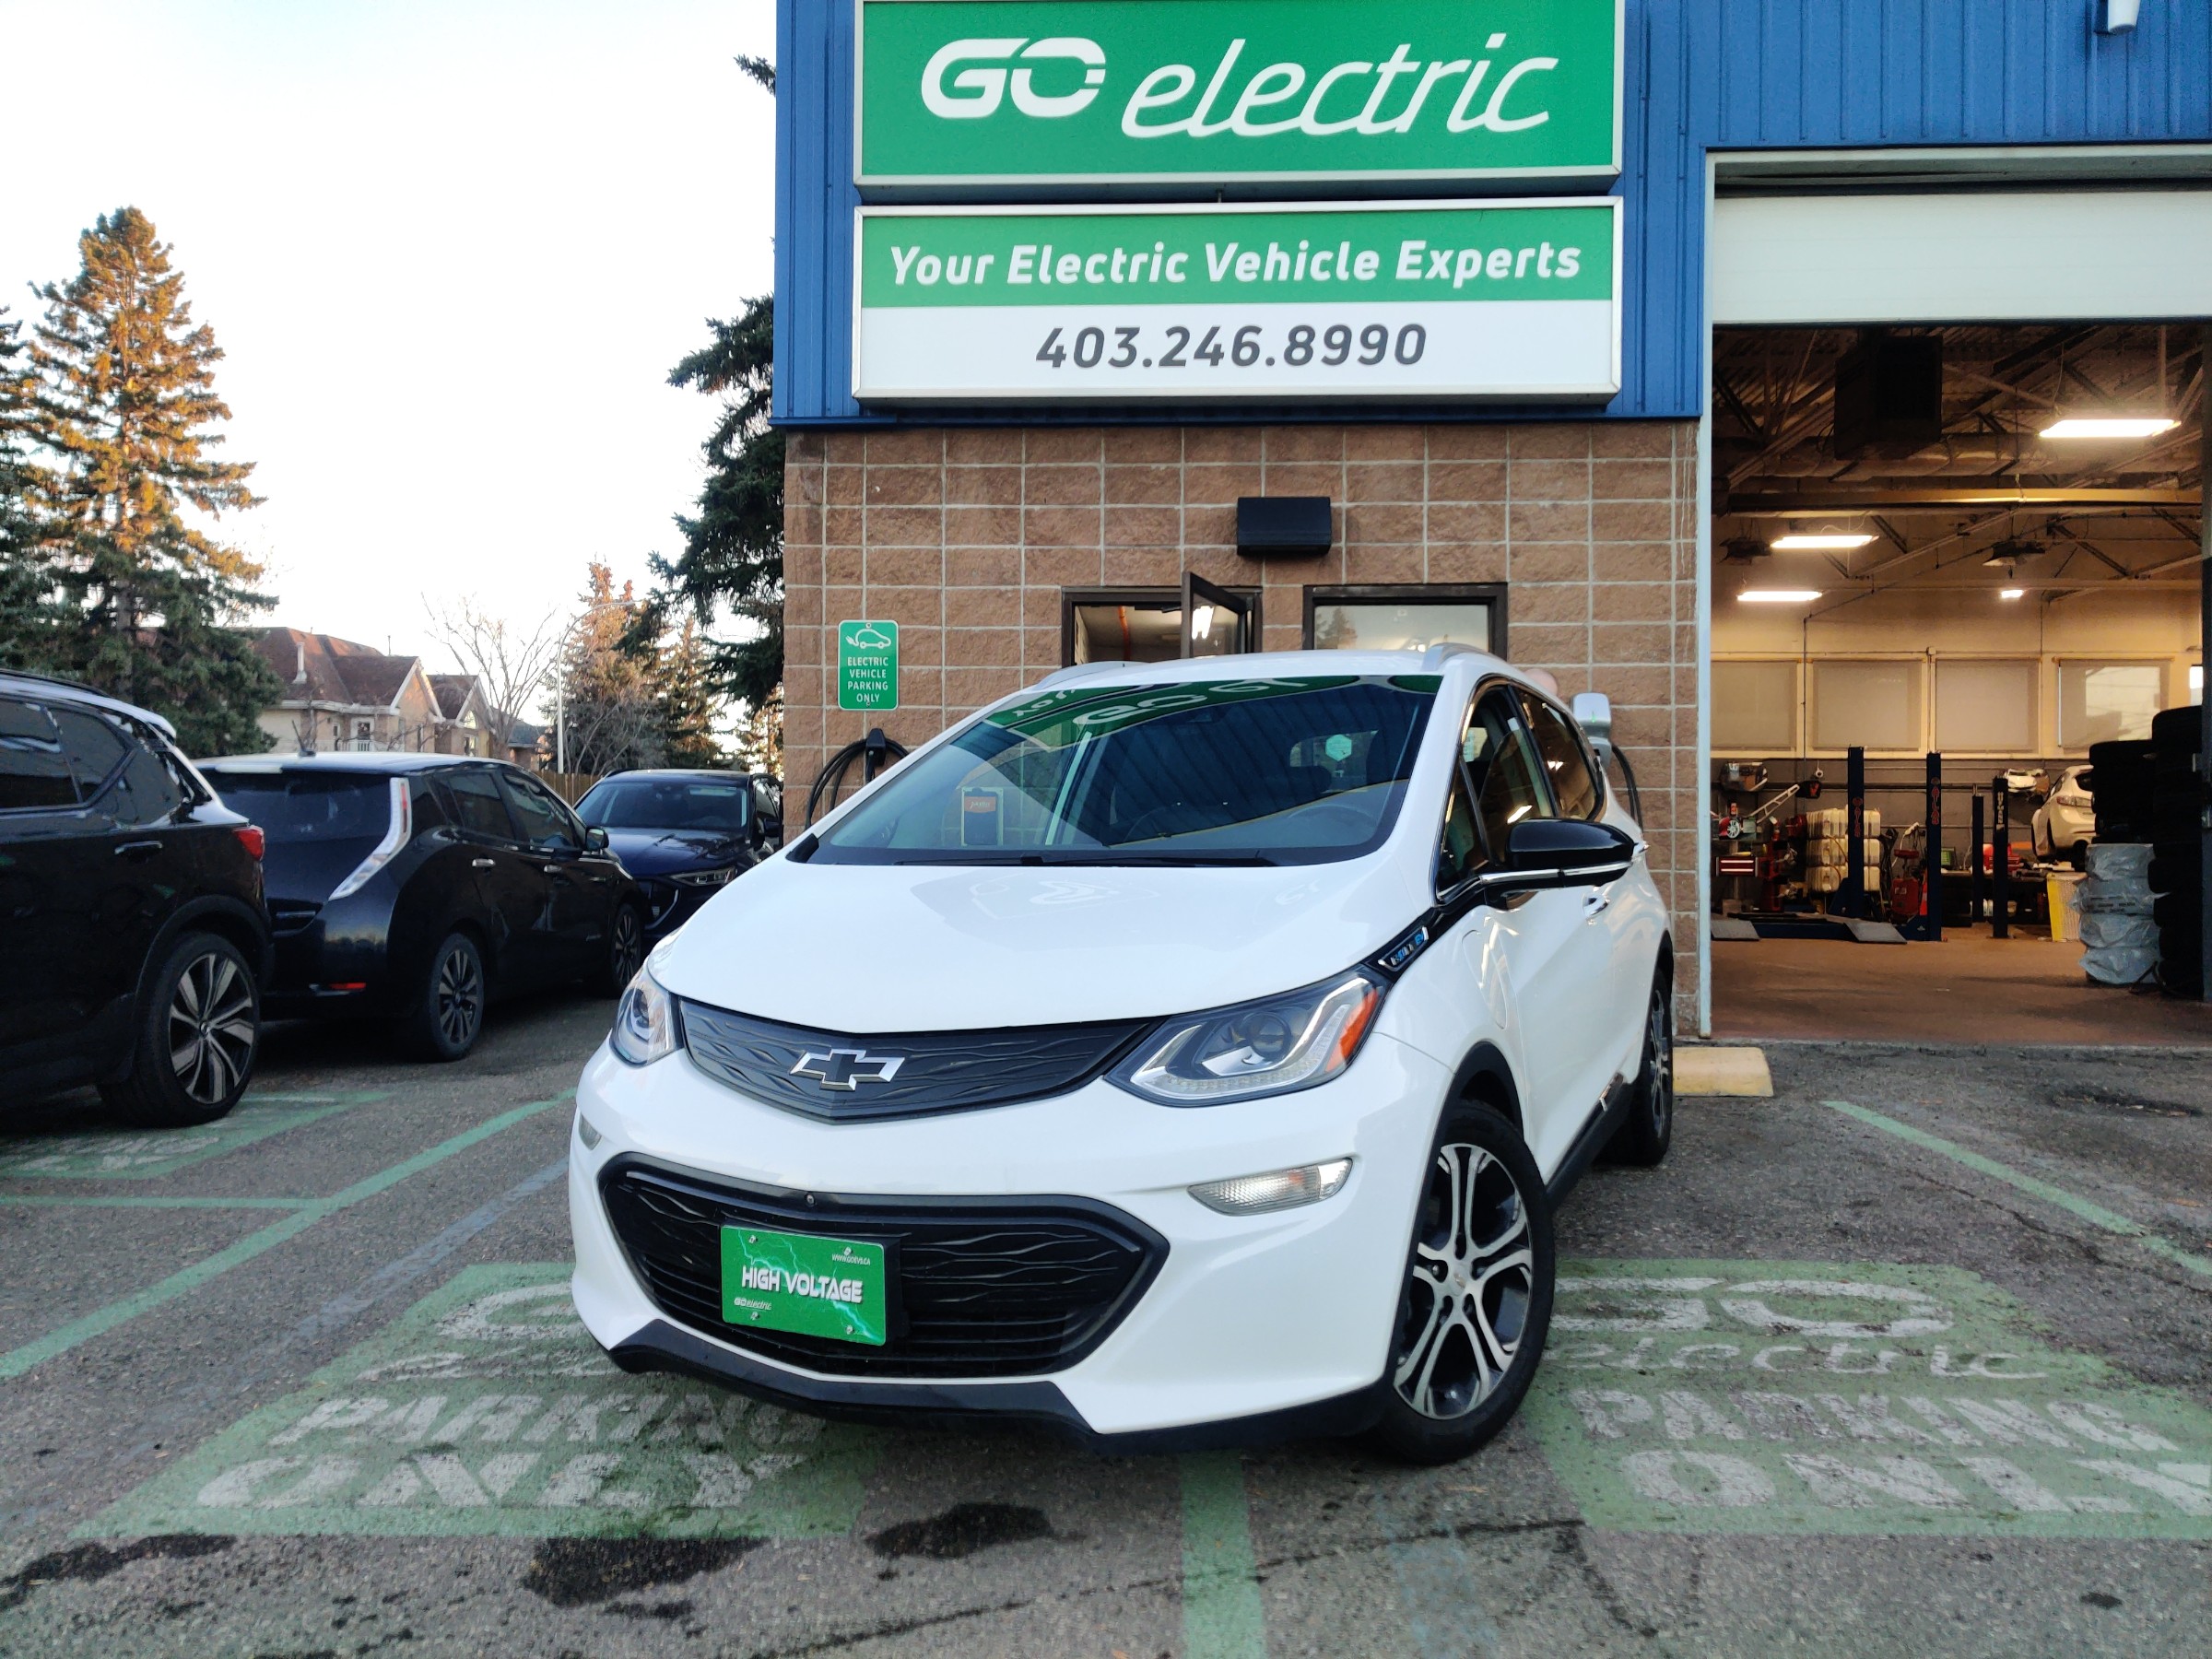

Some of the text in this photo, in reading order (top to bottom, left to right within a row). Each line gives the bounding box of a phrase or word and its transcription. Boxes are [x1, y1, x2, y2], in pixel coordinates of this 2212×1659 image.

[921, 33, 1559, 138] GO electric
[890, 240, 1581, 288] Your Electric Vehicle Experts
[1035, 324, 1427, 369] 403.246.8990
[847, 656, 888, 666] ELECTRIC
[849, 668, 887, 678] VEHICLE
[847, 681, 888, 690] PARKING
[856, 693, 880, 702] ONLY
[741, 1265, 863, 1303] HIGH VOLTAGE
[1571, 1389, 2179, 1453] PARKING
